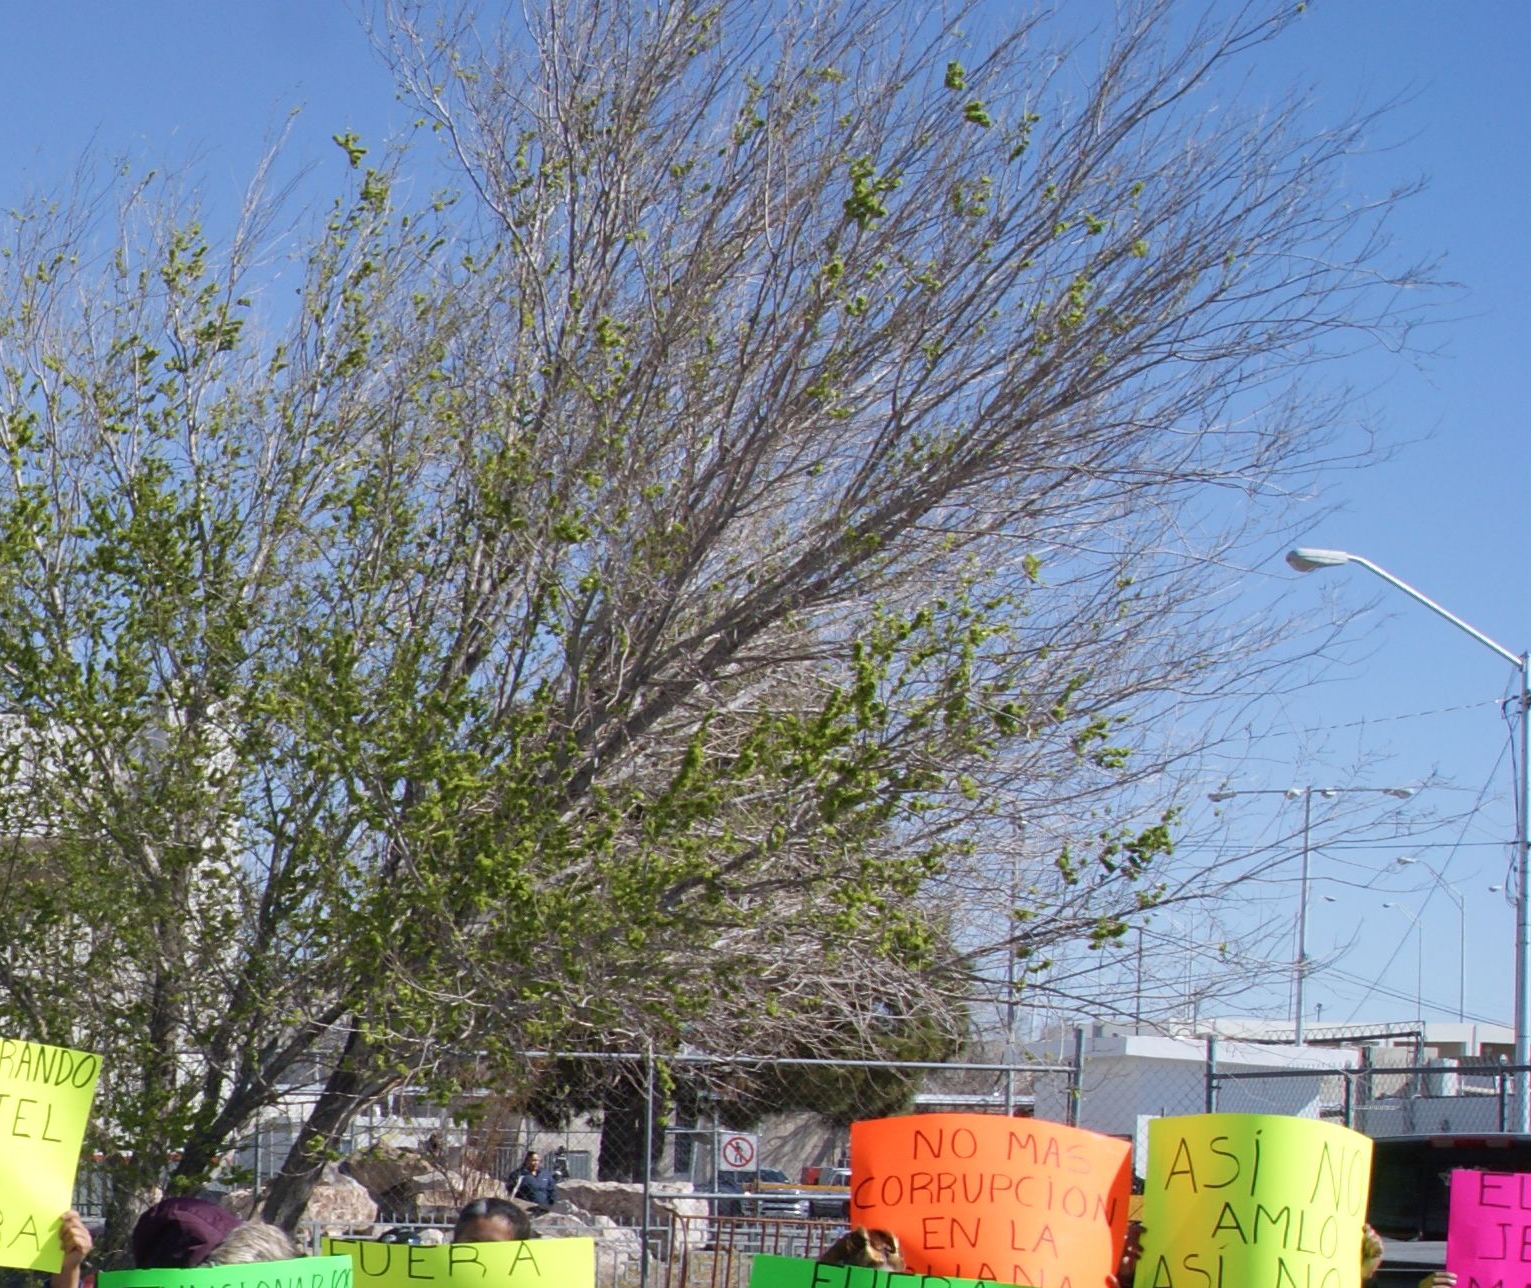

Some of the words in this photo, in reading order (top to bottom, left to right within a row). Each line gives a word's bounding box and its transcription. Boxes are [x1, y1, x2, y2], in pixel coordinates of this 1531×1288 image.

[914, 1128, 978, 1160] NO
[1008, 1131, 1090, 1175] MAS
[1310, 1140, 1366, 1217] NO
[923, 1217, 981, 1250] EN
[1011, 1219, 1059, 1259] LA
[1212, 1202, 1339, 1260] AMLO
[329, 1238, 541, 1280] FUERA
